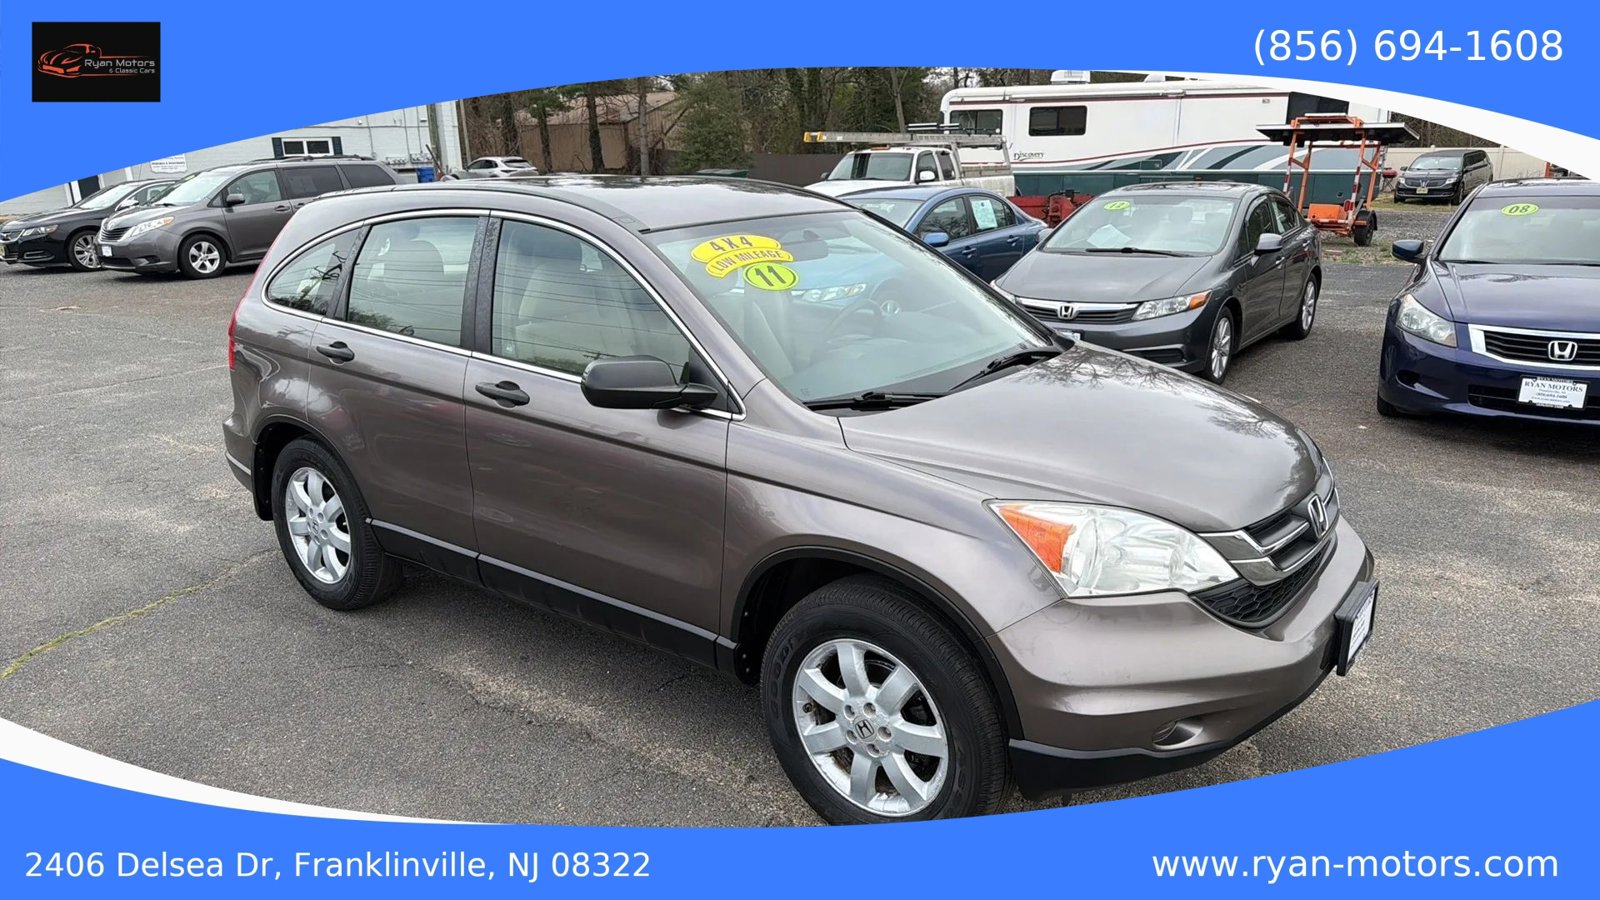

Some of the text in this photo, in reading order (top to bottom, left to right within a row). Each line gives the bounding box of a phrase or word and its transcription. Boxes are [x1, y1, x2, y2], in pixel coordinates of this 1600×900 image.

[1508, 205, 1531, 214] 08
[711, 250, 784, 272] LOW MILEAGE
[754, 265, 787, 287] 11
[1524, 380, 1546, 389] RYAN
[1547, 383, 1584, 393] MOTORS
